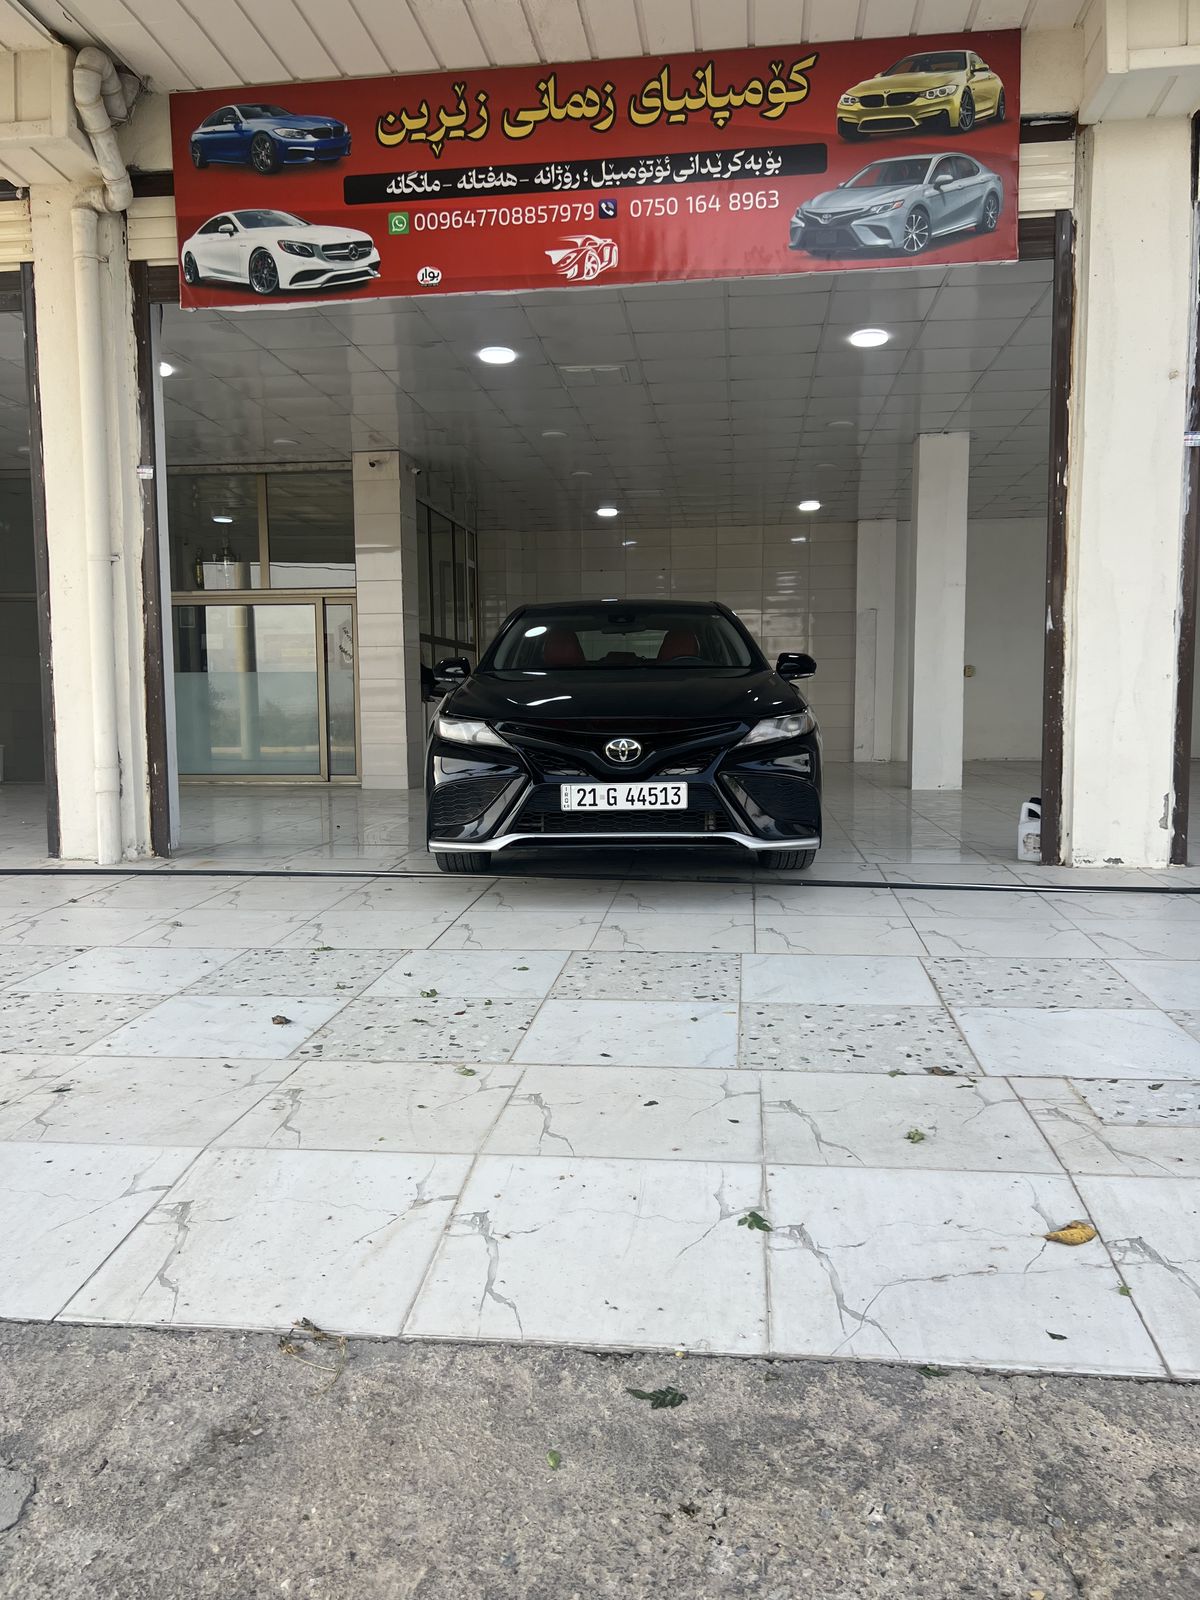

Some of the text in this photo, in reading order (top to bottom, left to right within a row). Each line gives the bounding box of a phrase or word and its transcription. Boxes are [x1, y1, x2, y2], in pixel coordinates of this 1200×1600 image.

[629, 53, 819, 129] کۆمپانیای
[376, 81, 489, 159] زێڕین
[763, 150, 783, 176] بۆ
[386, 171, 441, 194] مانگانە
[456, 166, 518, 190] هەفتانە
[413, 202, 595, 231] 009647708857979
[629, 190, 780, 218] 0750 164 8963
[420, 268, 440, 282] بوار
[577, 786, 681, 806] 21 G 44513
